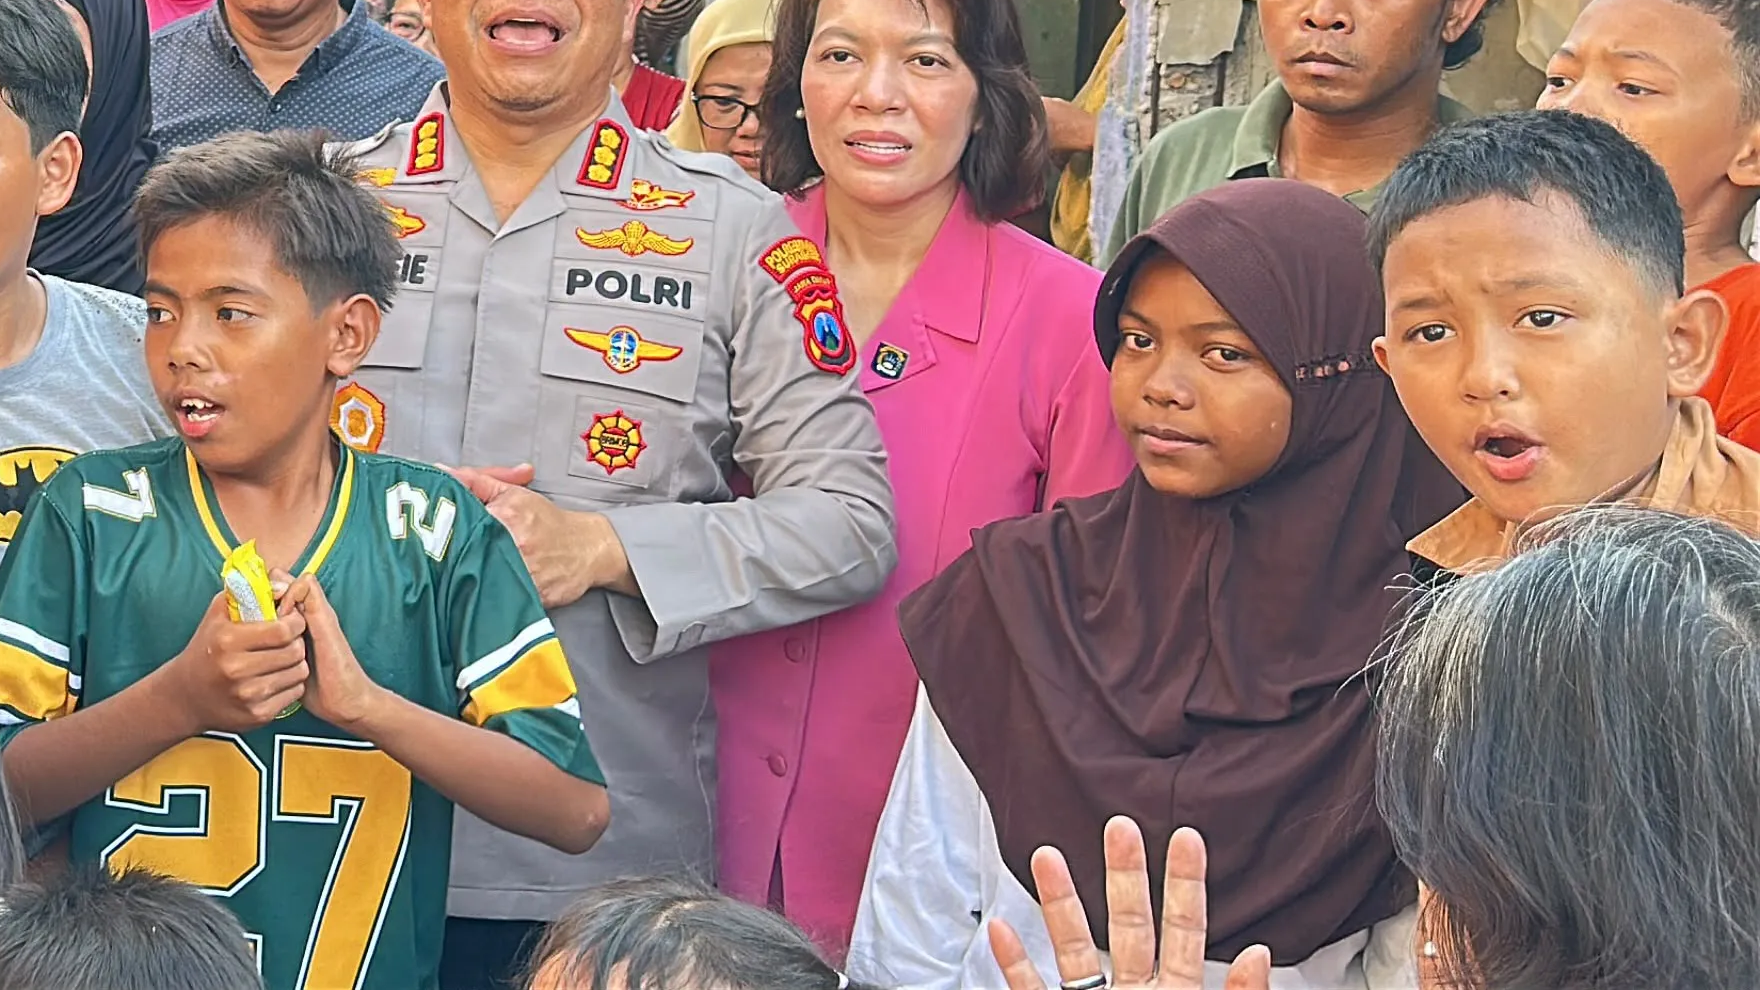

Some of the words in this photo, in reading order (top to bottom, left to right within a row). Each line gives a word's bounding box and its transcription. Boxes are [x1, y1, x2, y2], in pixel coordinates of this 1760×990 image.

[566, 268, 692, 310] POLRI
[385, 481, 457, 562] 2
[100, 730, 413, 990] 27
